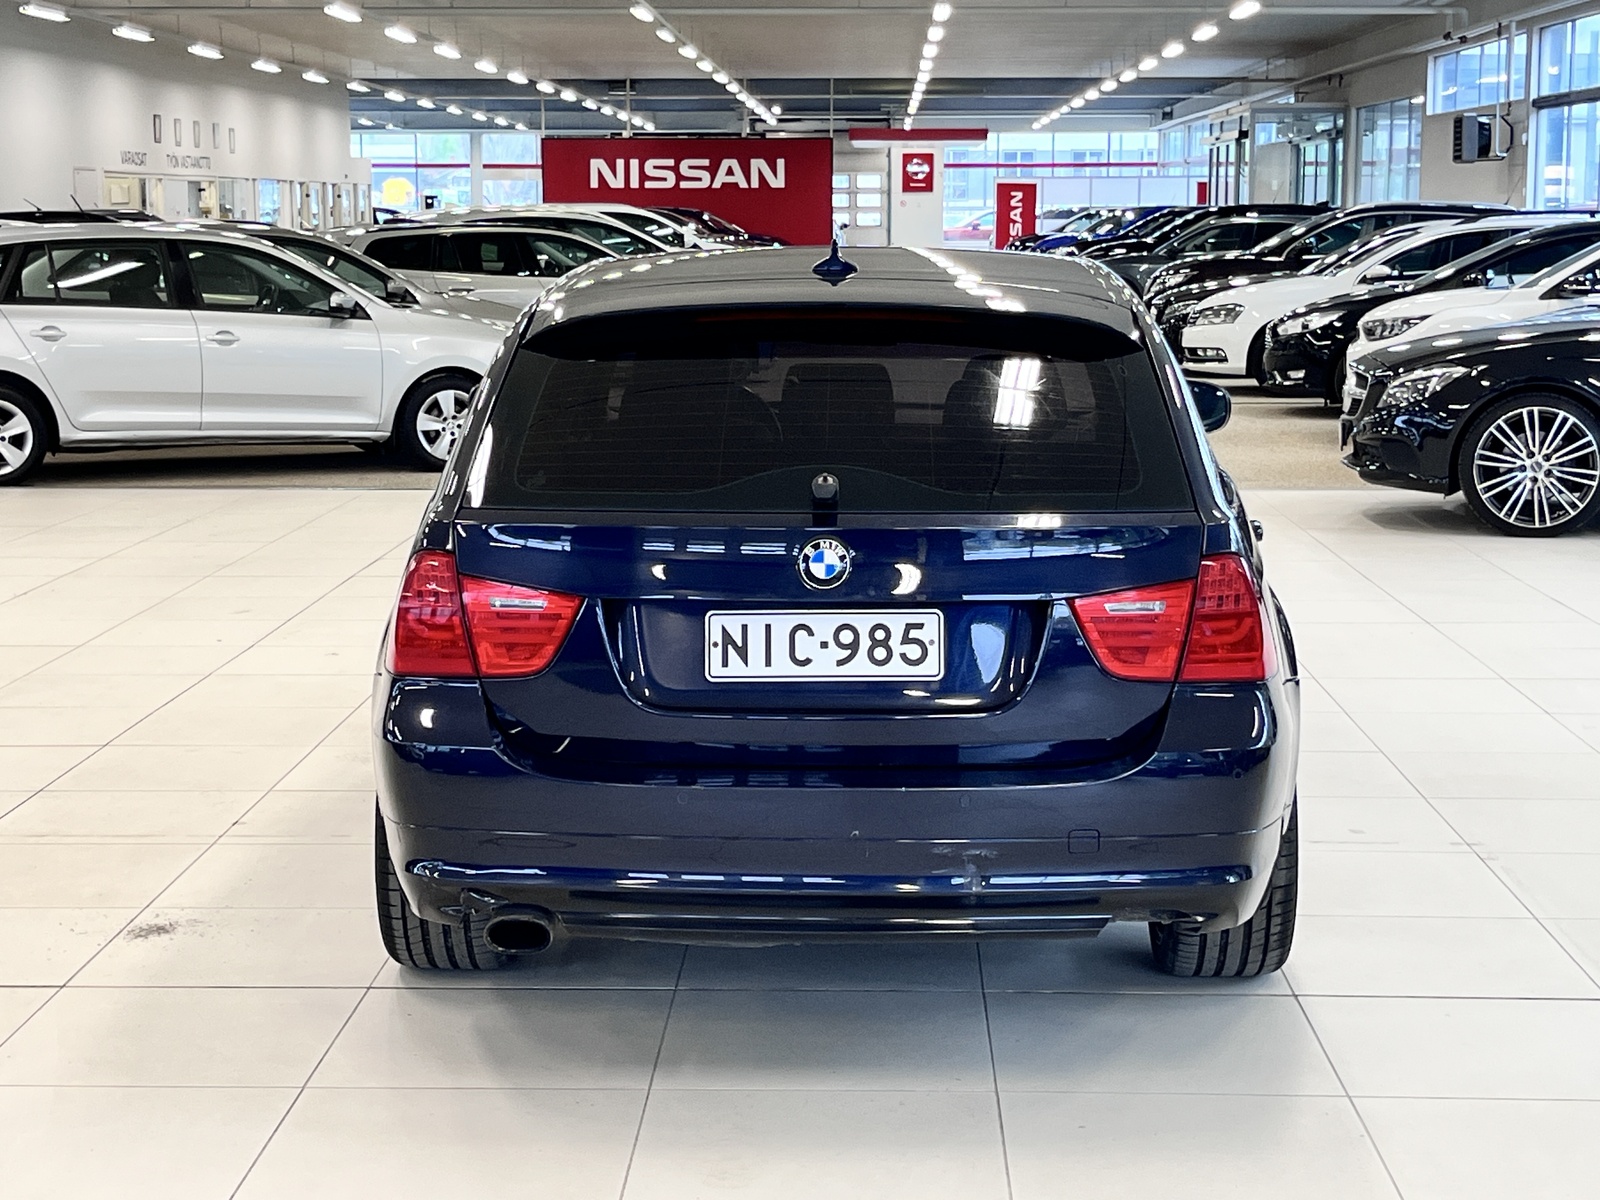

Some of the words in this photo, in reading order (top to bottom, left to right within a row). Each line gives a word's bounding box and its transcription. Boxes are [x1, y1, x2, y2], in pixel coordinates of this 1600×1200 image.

[589, 158, 786, 189] NISSAN
[1009, 191, 1023, 240] SAN
[804, 541, 847, 557] BMW
